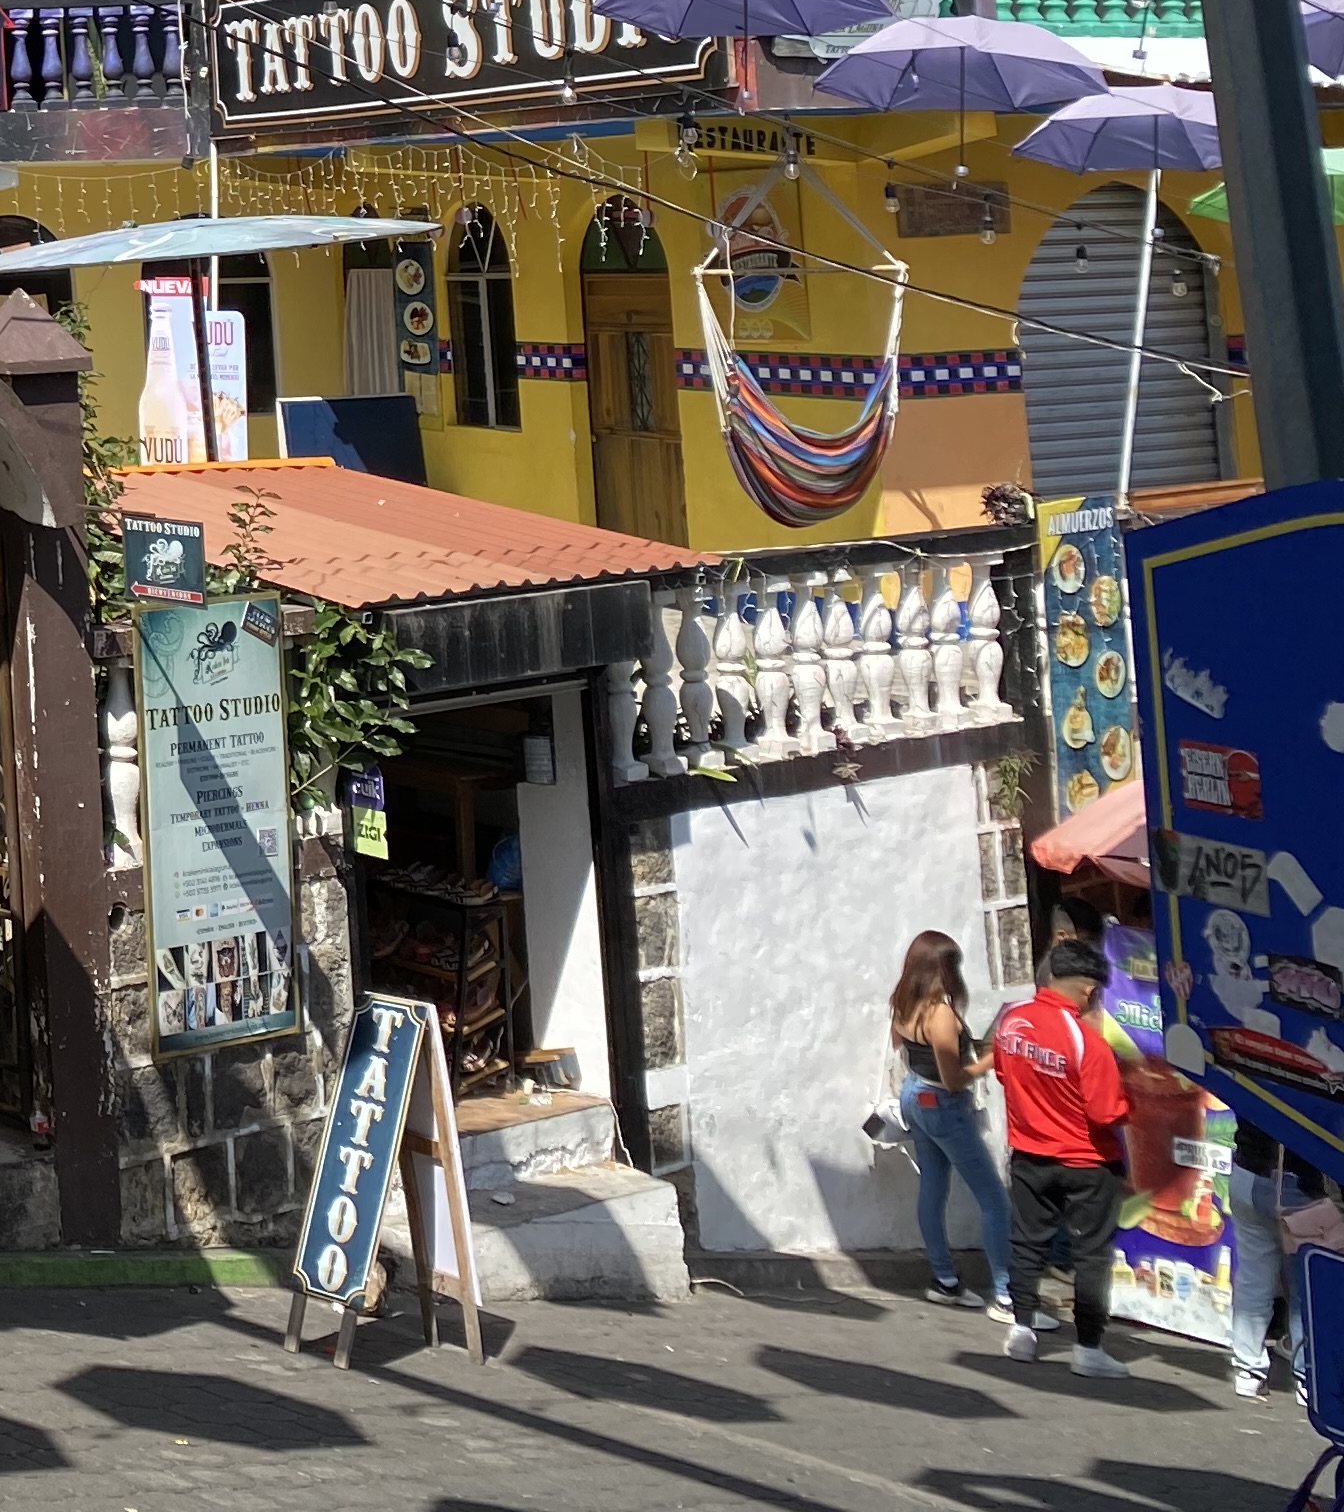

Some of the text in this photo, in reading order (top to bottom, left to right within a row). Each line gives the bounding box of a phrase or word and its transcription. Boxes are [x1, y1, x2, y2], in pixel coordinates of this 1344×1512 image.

[124, 518, 200, 538] TATTOO STUDIO
[1047, 506, 1114, 536] ALMUERZOS
[146, 692, 280, 731] TATTOO STUDIO
[170, 731, 265, 757] PERMANENT TATTOO
[196, 785, 244, 805] PIERCINGS
[170, 809, 212, 825] TEMPORARY
[317, 1007, 405, 1291] TATTOO
